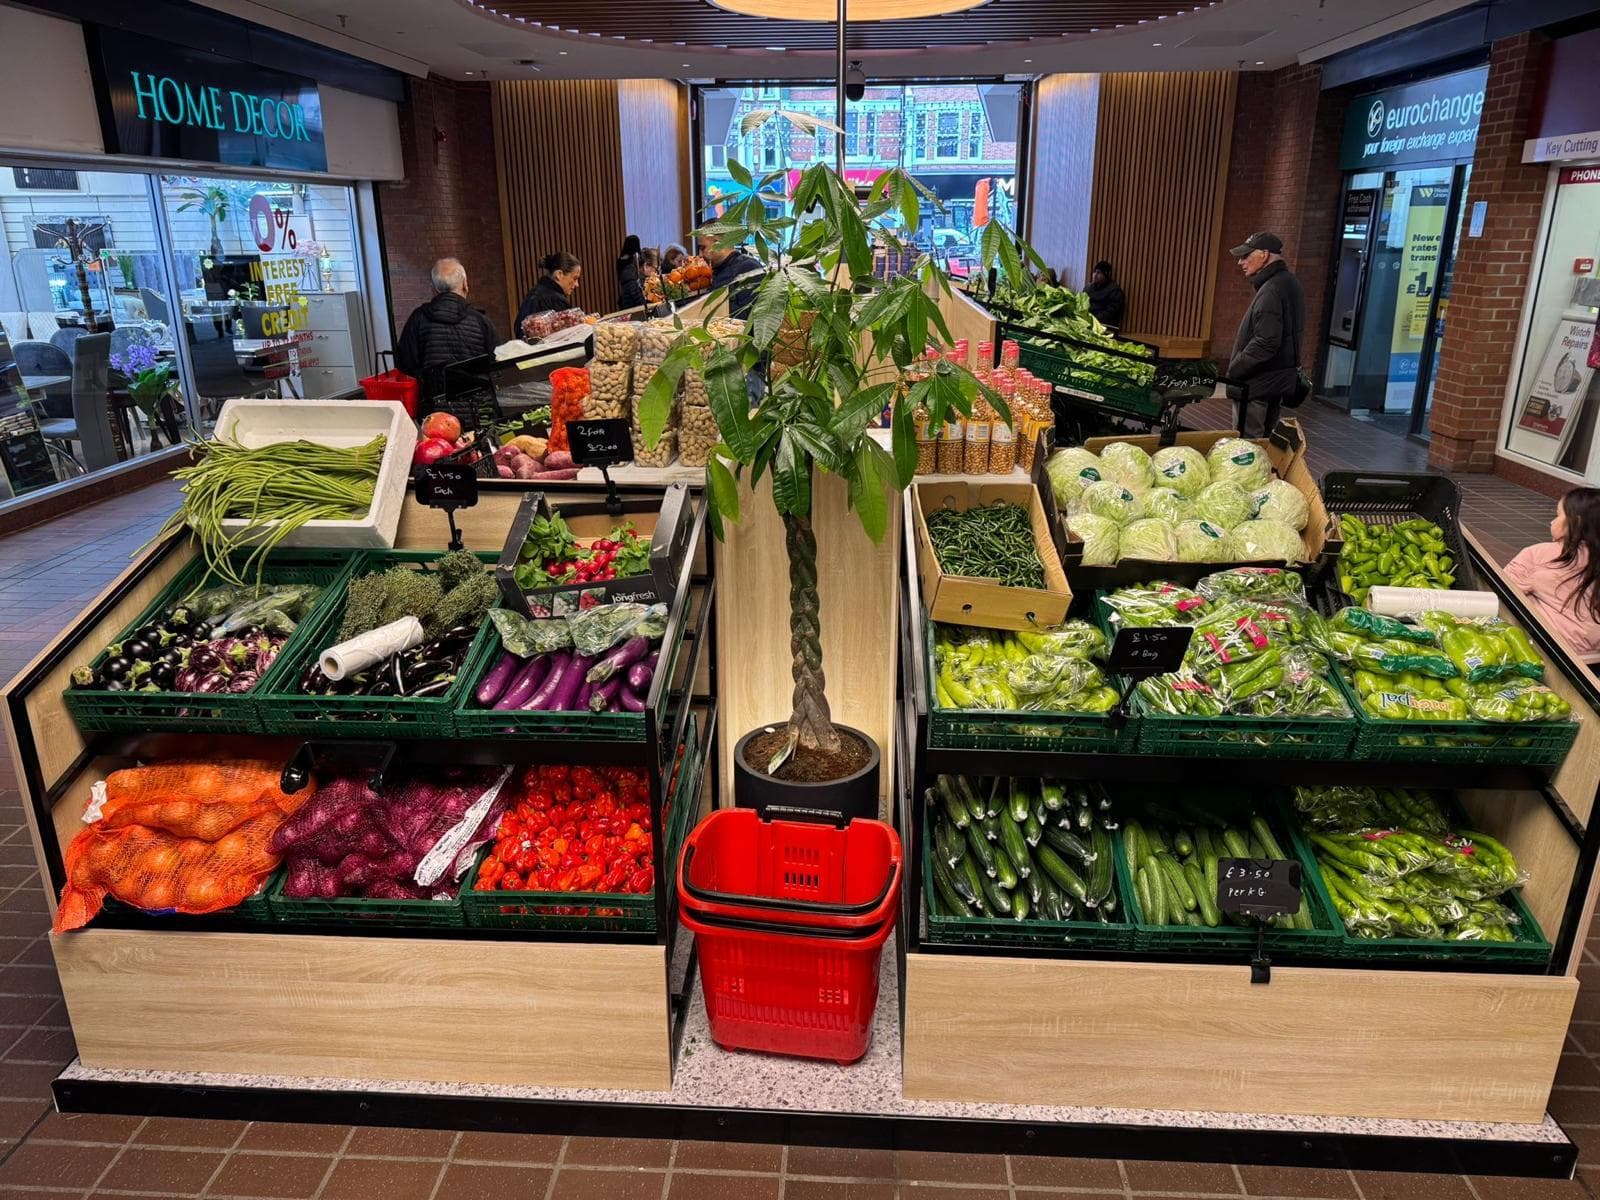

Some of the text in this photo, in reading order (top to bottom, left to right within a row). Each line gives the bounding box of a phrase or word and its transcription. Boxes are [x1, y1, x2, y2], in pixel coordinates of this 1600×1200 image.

[131, 71, 312, 142] HOME DECOR
[1386, 91, 1484, 130] eurochange
[1362, 141, 1380, 158] your
[1380, 136, 1406, 154] foreign
[1407, 131, 1447, 150] exchange
[1545, 138, 1599, 157] Key Cutting
[249, 194, 297, 252] 0%
[1411, 244, 1438, 252] rates
[1412, 233, 1435, 242] New
[249, 258, 305, 282] INTEREST
[267, 282, 299, 306] FREE
[261, 306, 310, 337] CREDIT
[1569, 325, 1591, 338] Watch
[1561, 336, 1589, 350] Repairs
[577, 425, 587, 436] 2
[1225, 866, 1270, 879] £3.50
